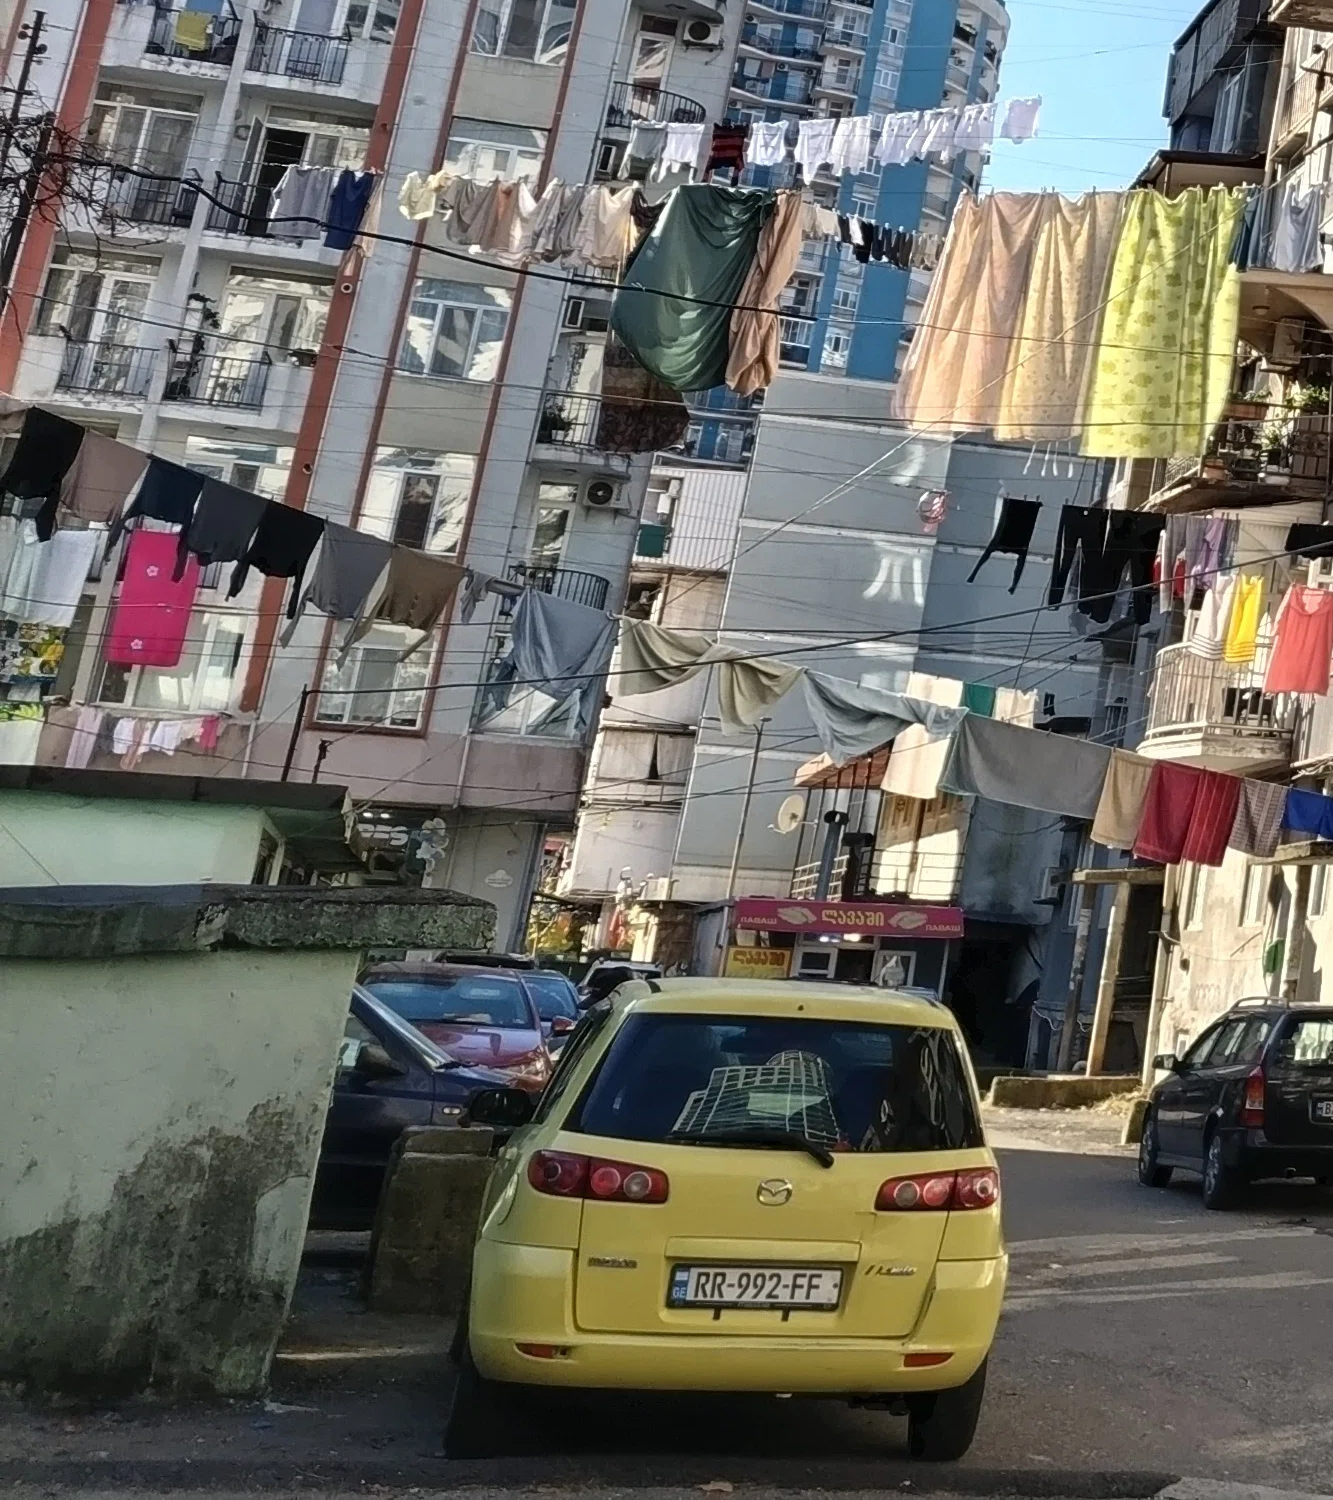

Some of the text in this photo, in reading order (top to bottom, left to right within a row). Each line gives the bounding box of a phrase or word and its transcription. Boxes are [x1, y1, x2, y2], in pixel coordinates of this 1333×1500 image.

[821, 909, 885, 927] ლავაში
[672, 1271, 823, 1300] GE RR-992-FF
